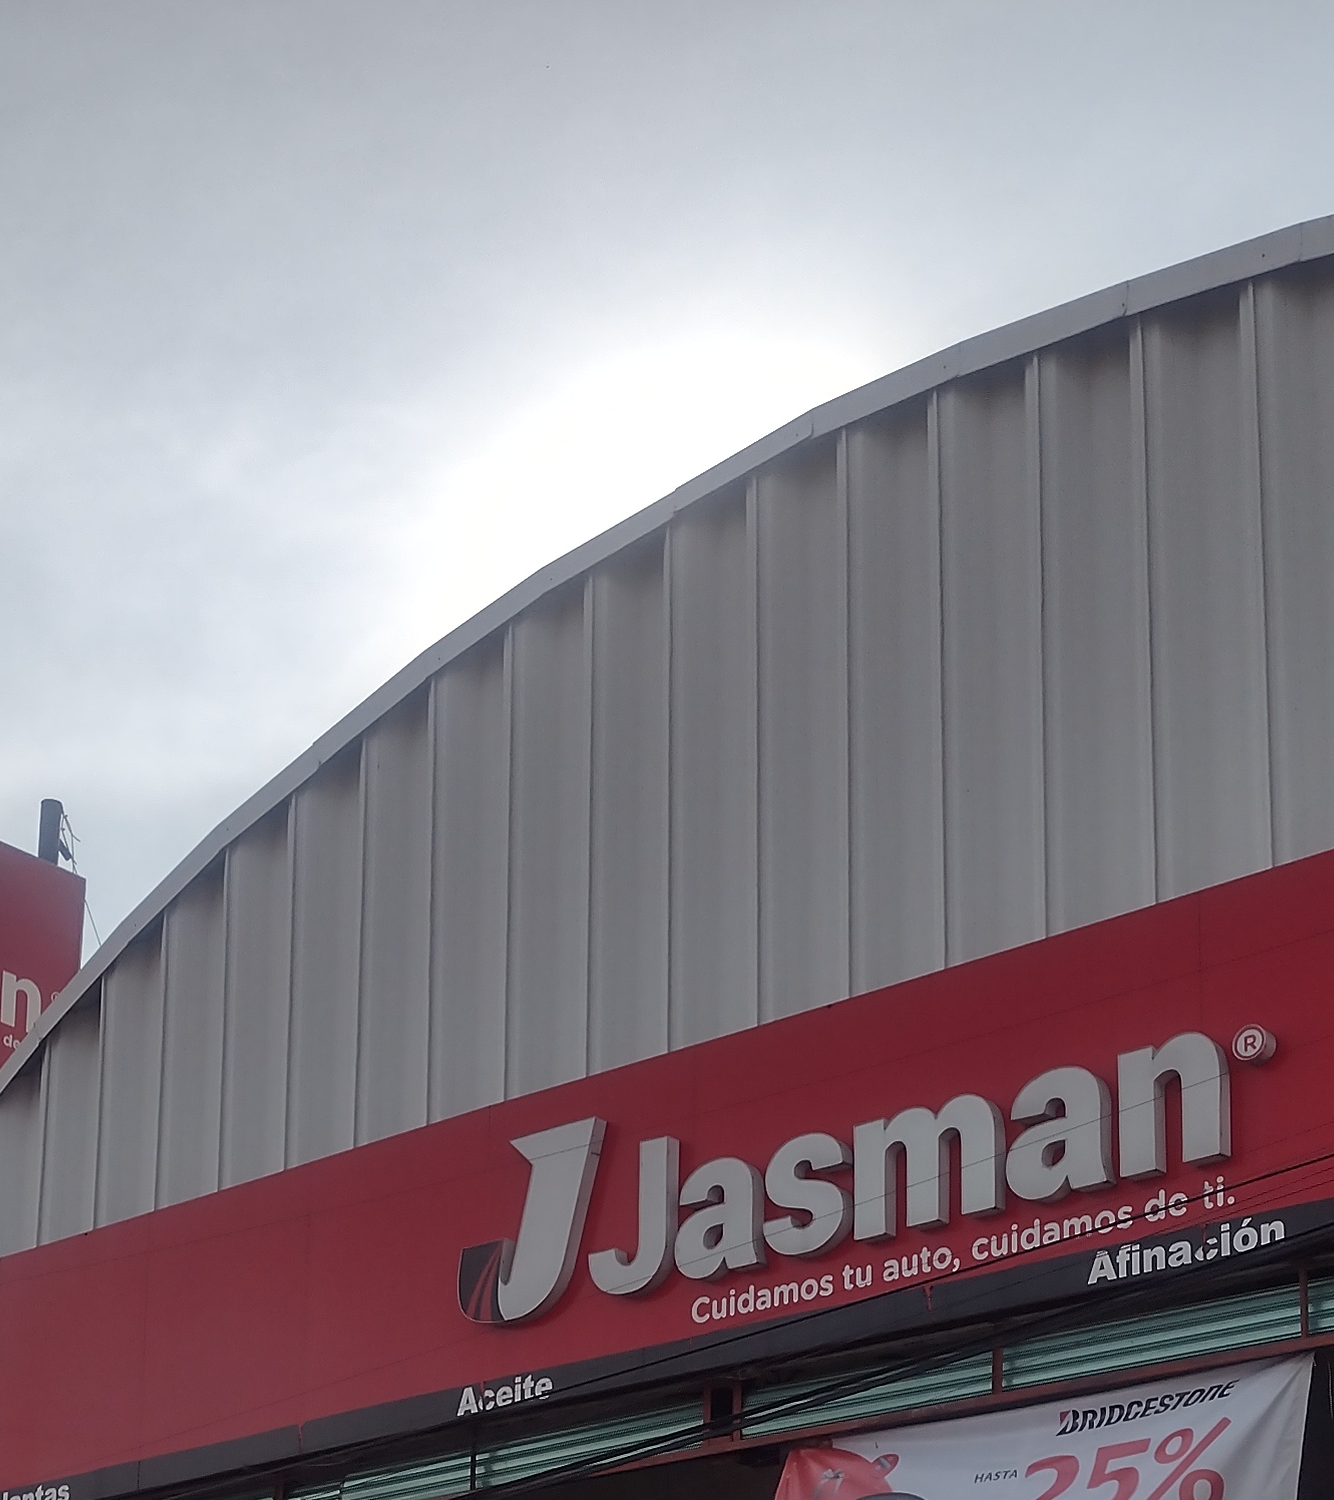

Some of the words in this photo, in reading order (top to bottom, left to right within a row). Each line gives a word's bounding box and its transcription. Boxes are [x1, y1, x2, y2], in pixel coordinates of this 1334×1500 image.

[588, 1029, 1232, 1296] Jasman
[690, 1274, 834, 1324] Cuidamos
[842, 1263, 873, 1292] tu
[882, 1244, 961, 1283] auto,
[971, 1206, 1133, 1262] cuidamos
[1143, 1188, 1189, 1223] de
[1087, 1216, 1286, 1285] Afinación
[456, 1373, 553, 1418] Aceite
[1056, 1379, 1241, 1437] BRIDGESTONE
[974, 1469, 1018, 1484] HASTA
